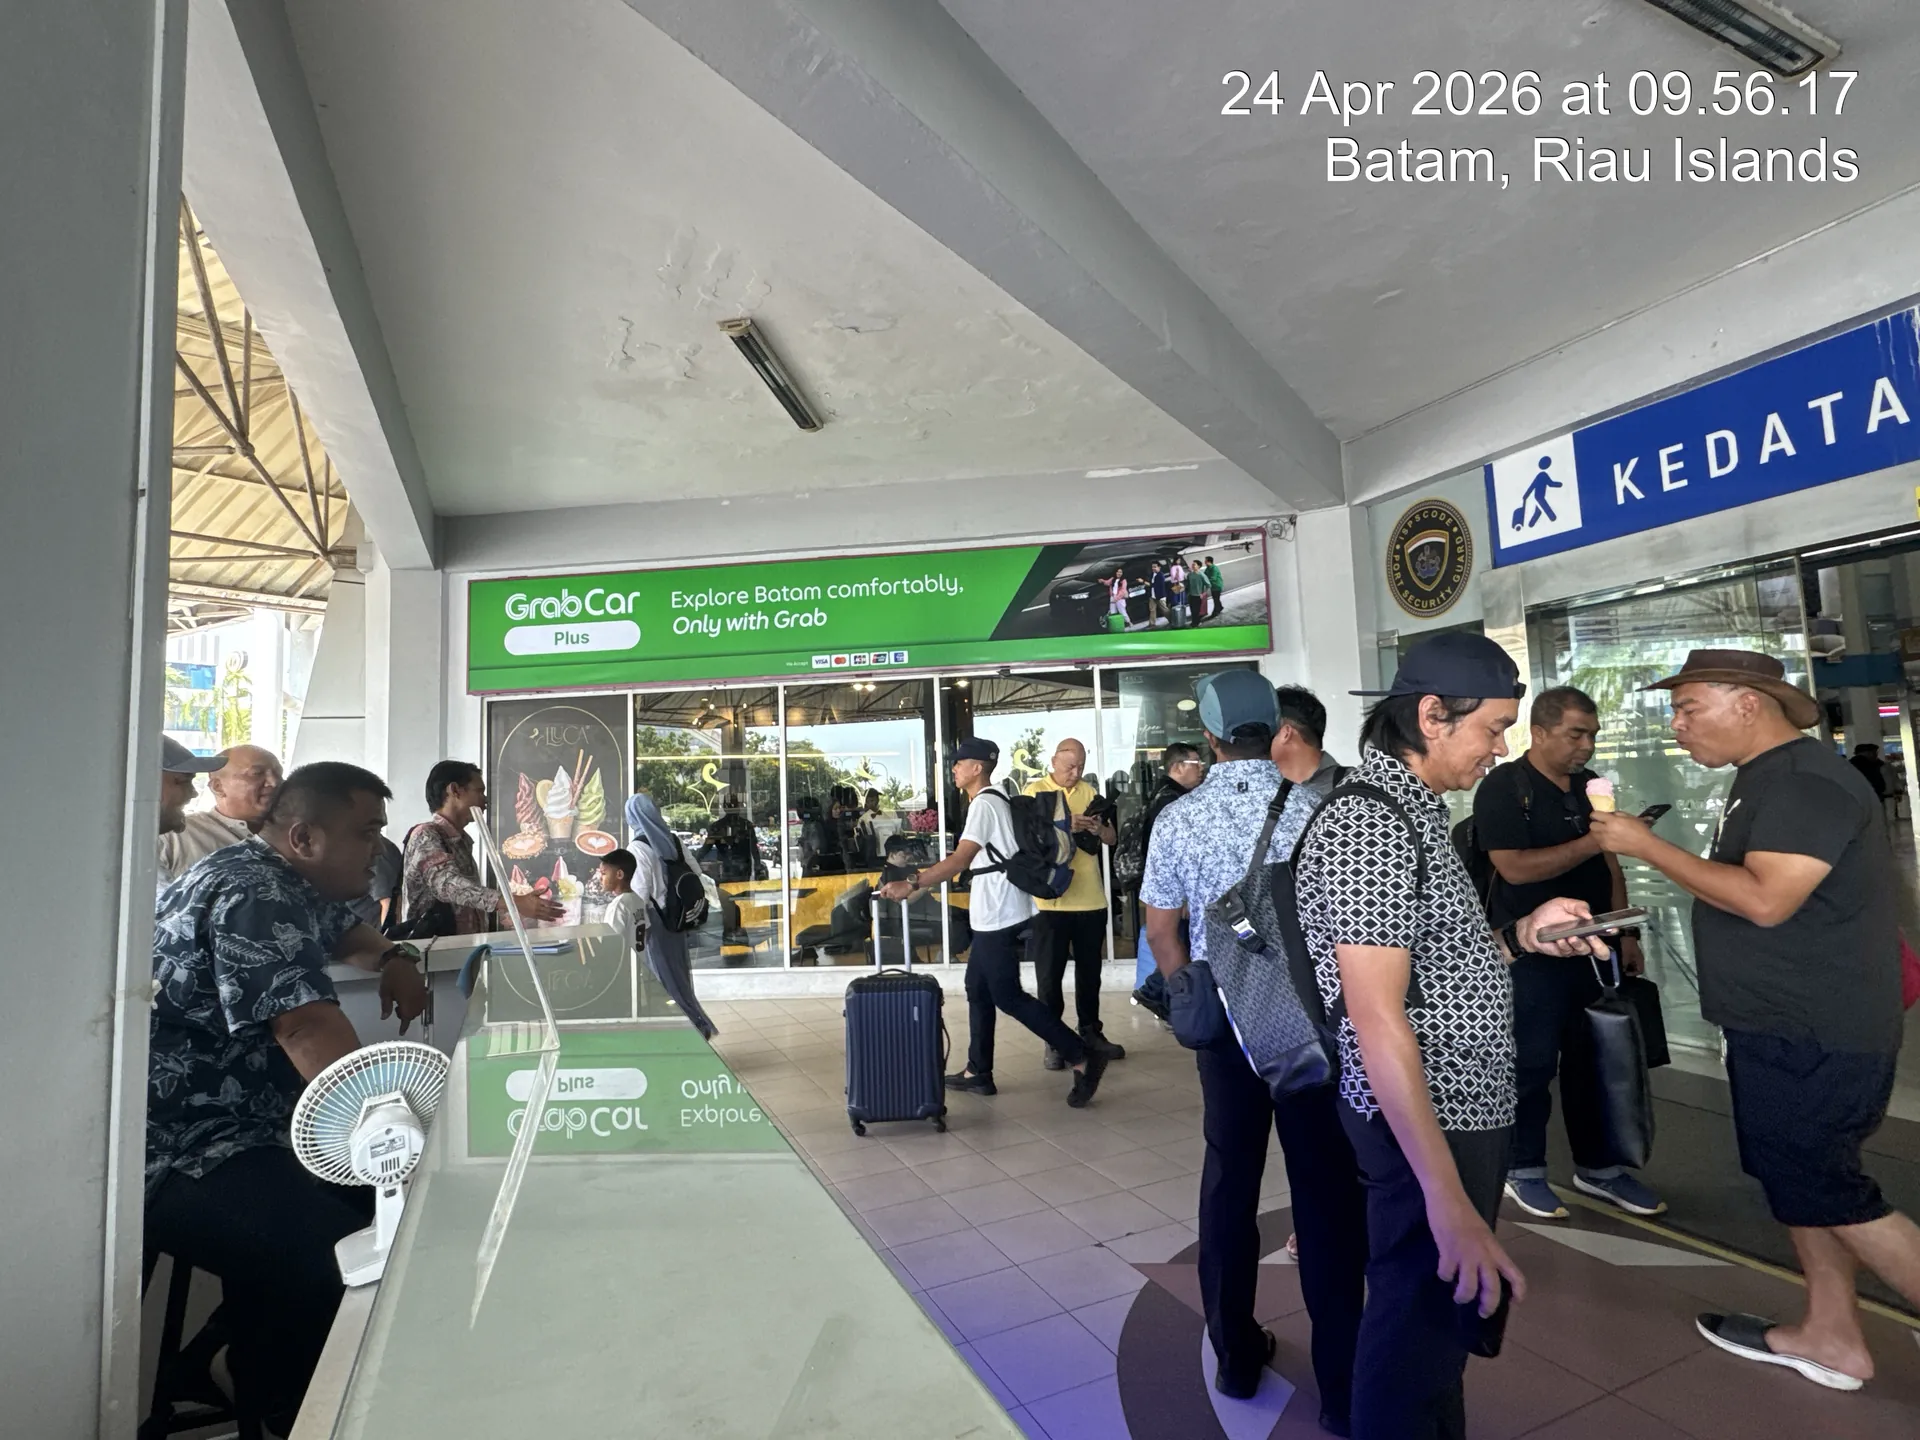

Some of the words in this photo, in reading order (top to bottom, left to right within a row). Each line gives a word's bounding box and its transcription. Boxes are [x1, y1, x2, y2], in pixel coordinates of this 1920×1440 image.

[1613, 377, 1911, 506] KEDATA
[1392, 554, 1404, 587] PORT
[1402, 586, 1453, 609] SECURITY
[1453, 536, 1465, 583] GUARD
[671, 588, 749, 612] Explore
[755, 585, 821, 604] Batam
[826, 573, 964, 600] comfortably,
[554, 631, 590, 646] Plus
[672, 614, 722, 638] Only
[726, 610, 769, 632] with
[773, 607, 828, 629] Grab
